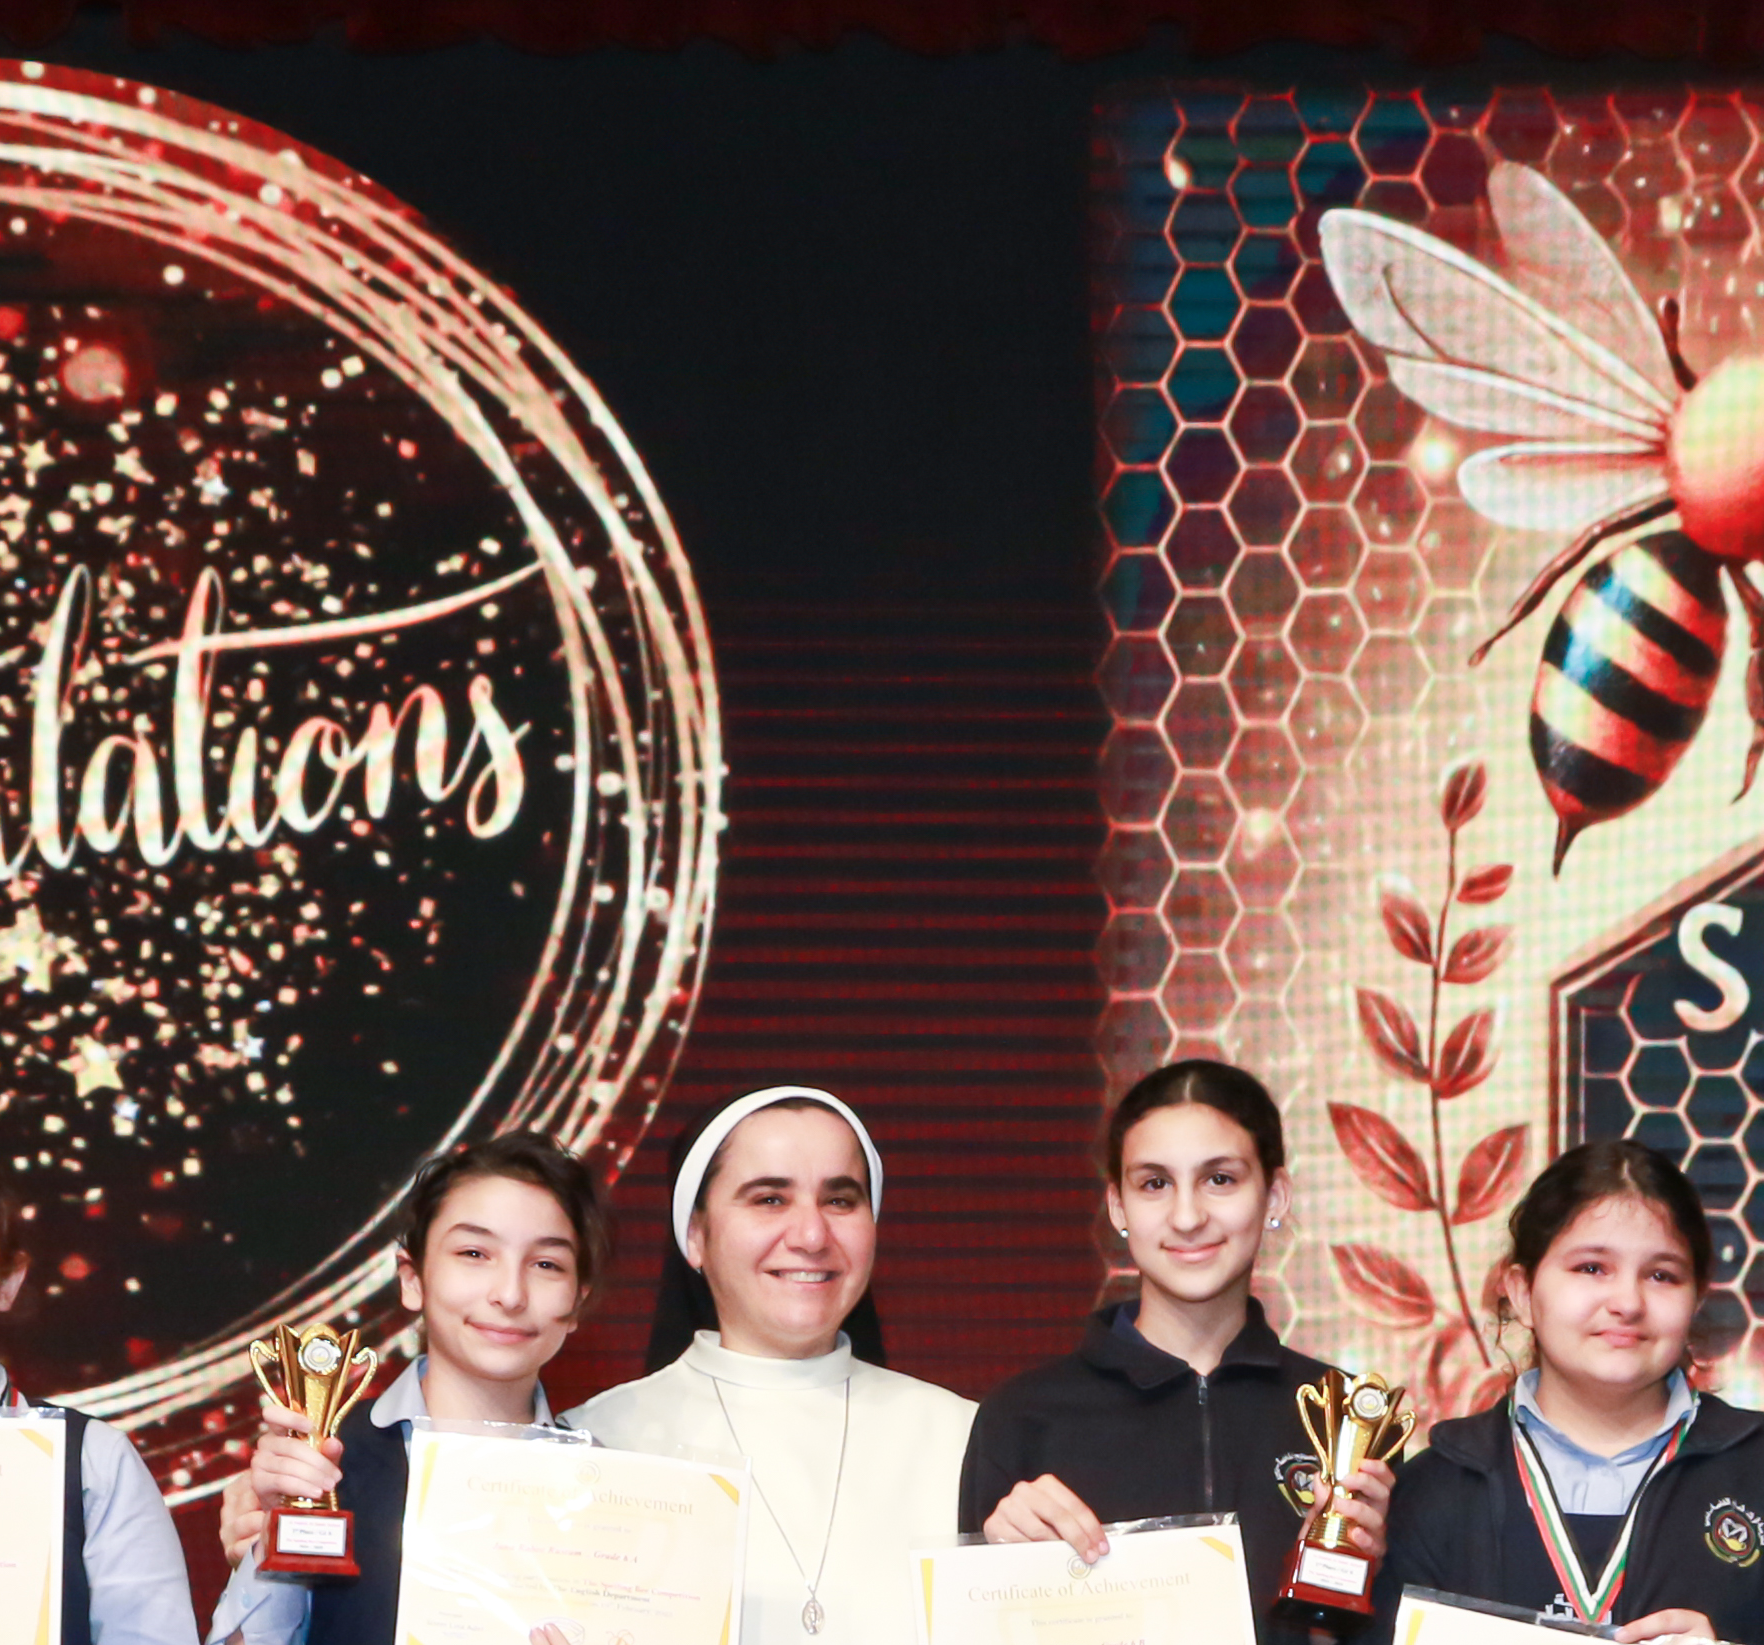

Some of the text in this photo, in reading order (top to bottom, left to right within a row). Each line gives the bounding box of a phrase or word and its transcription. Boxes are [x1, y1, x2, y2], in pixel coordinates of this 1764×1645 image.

[467, 1471, 554, 1500] Certificate
[570, 1586, 650, 1604] English Department
[967, 1569, 1190, 1603] Certificate of Achievement
